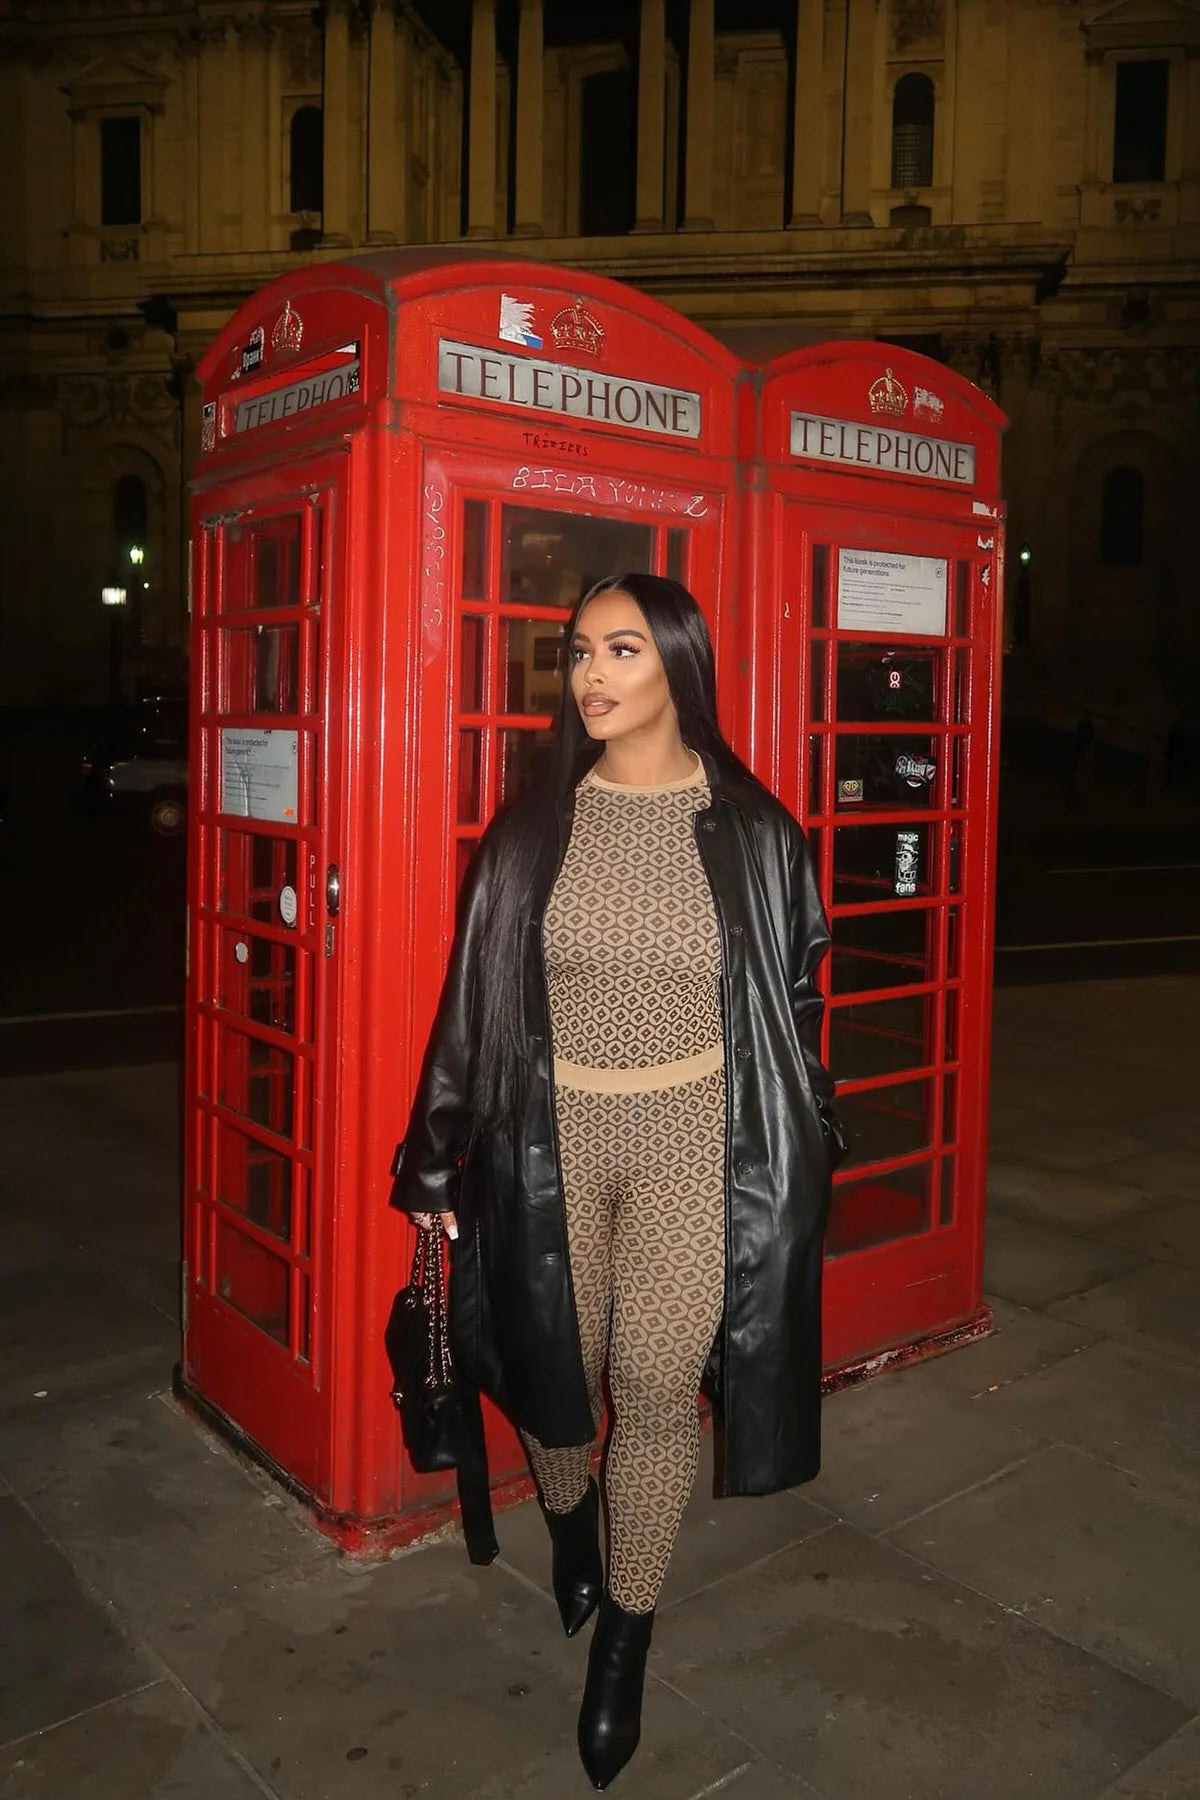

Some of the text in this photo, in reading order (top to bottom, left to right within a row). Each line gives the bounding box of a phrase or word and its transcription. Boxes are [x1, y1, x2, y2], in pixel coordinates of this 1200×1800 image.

[446, 352, 690, 432] TELEPHONE
[796, 417, 967, 480] TELEPHONE
[873, 560, 898, 569] protected
[897, 833, 919, 844] magic
[895, 882, 916, 893] fans
